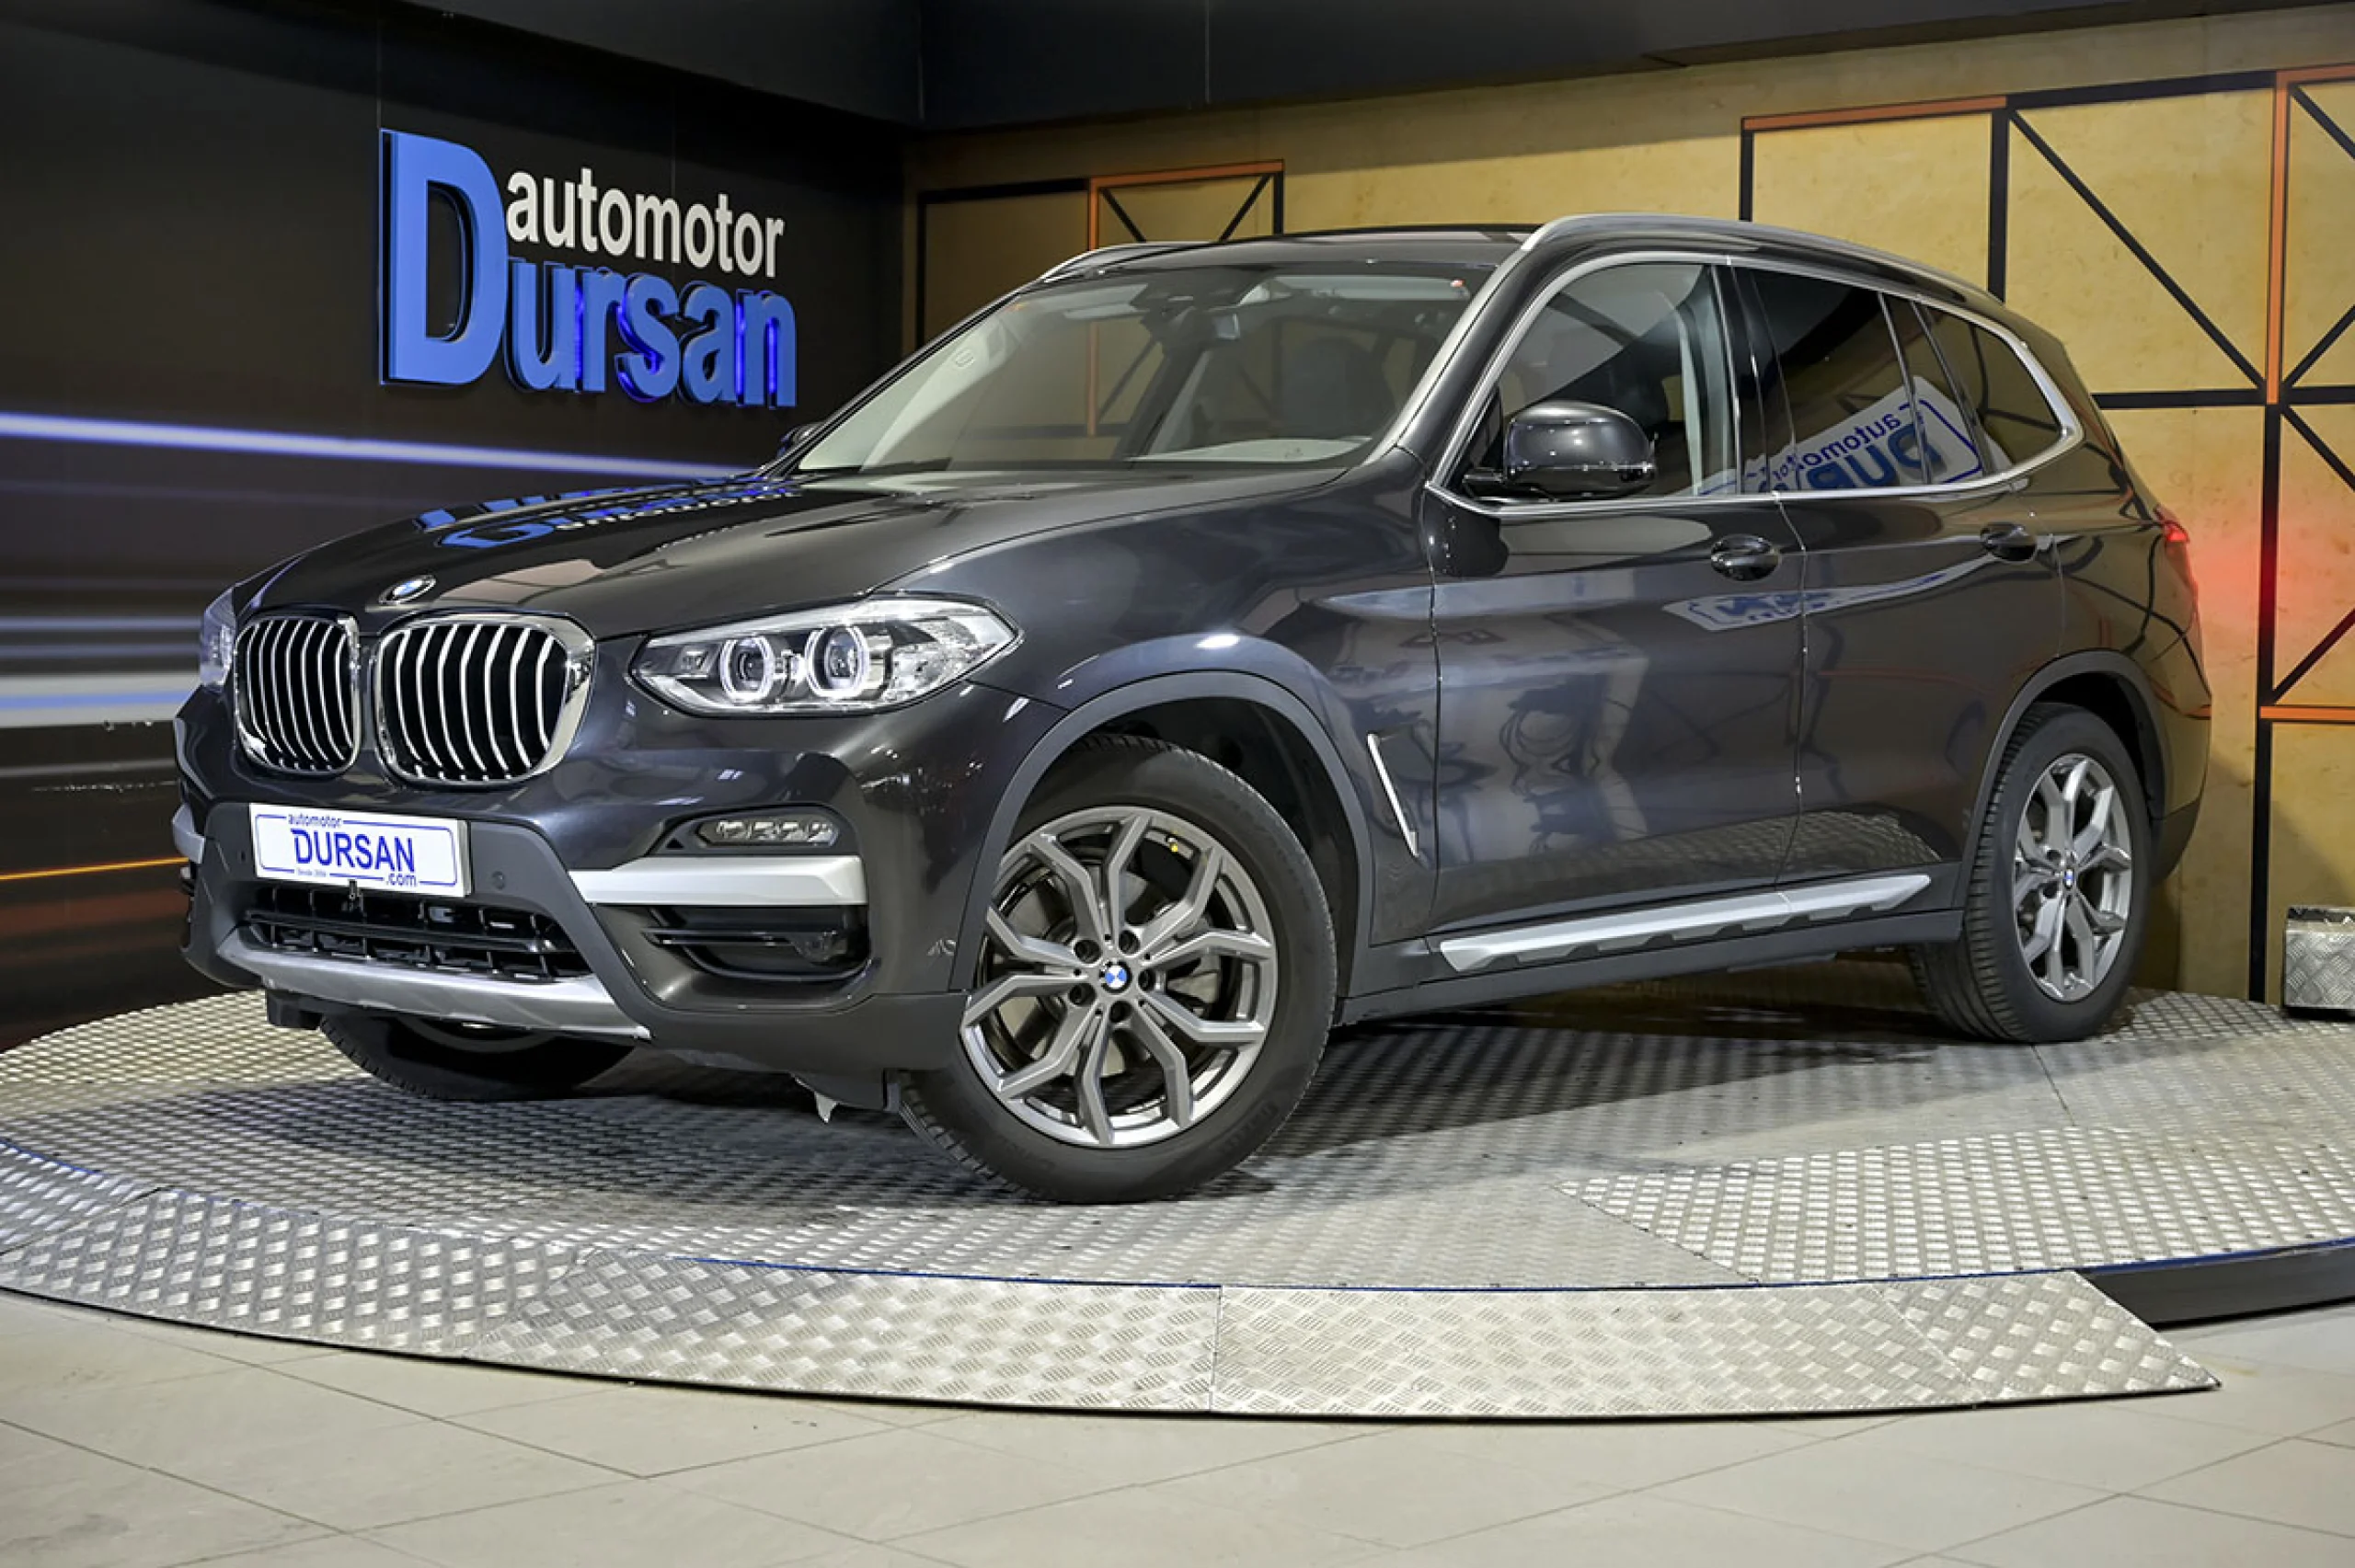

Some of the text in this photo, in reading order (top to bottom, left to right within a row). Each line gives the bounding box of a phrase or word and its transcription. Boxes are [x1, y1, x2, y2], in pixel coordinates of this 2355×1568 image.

[506, 167, 784, 278] automotor
[380, 128, 797, 408] Dursan
[288, 813, 342, 829] automotor
[290, 828, 416, 873] DURSAN
[385, 873, 418, 887] .com
